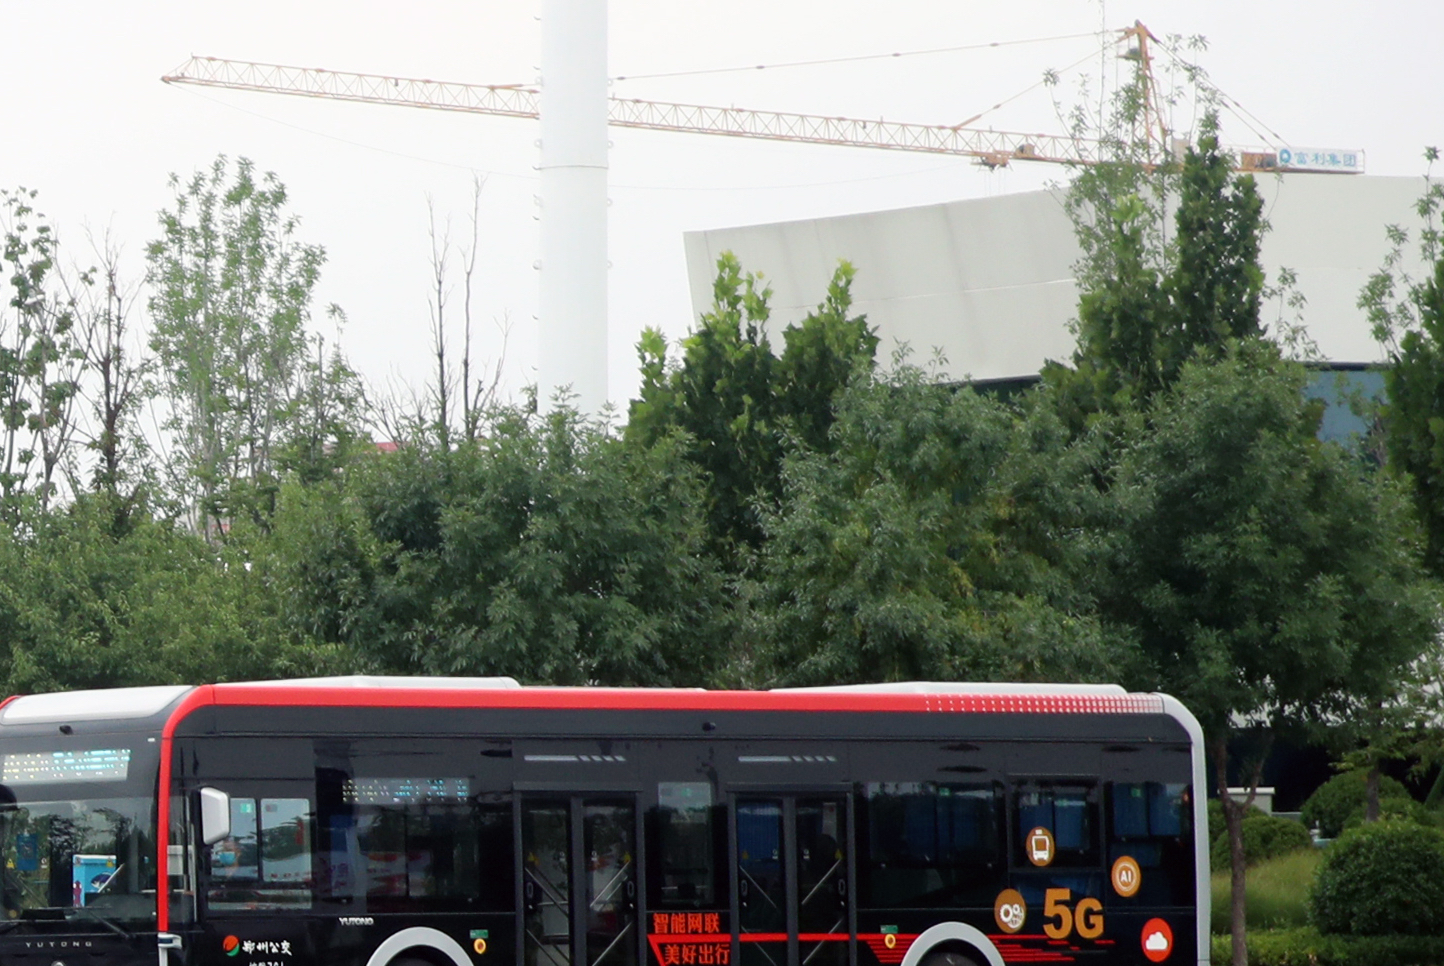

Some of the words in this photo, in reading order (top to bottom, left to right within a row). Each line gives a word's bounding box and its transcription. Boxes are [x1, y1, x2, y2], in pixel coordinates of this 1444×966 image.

[1120, 870, 1132, 883] AI
[653, 912, 720, 934] 智能网联
[1042, 887, 1104, 940] 5G
[242, 940, 292, 956] 郑州公交
[664, 944, 730, 965] 美好出行
